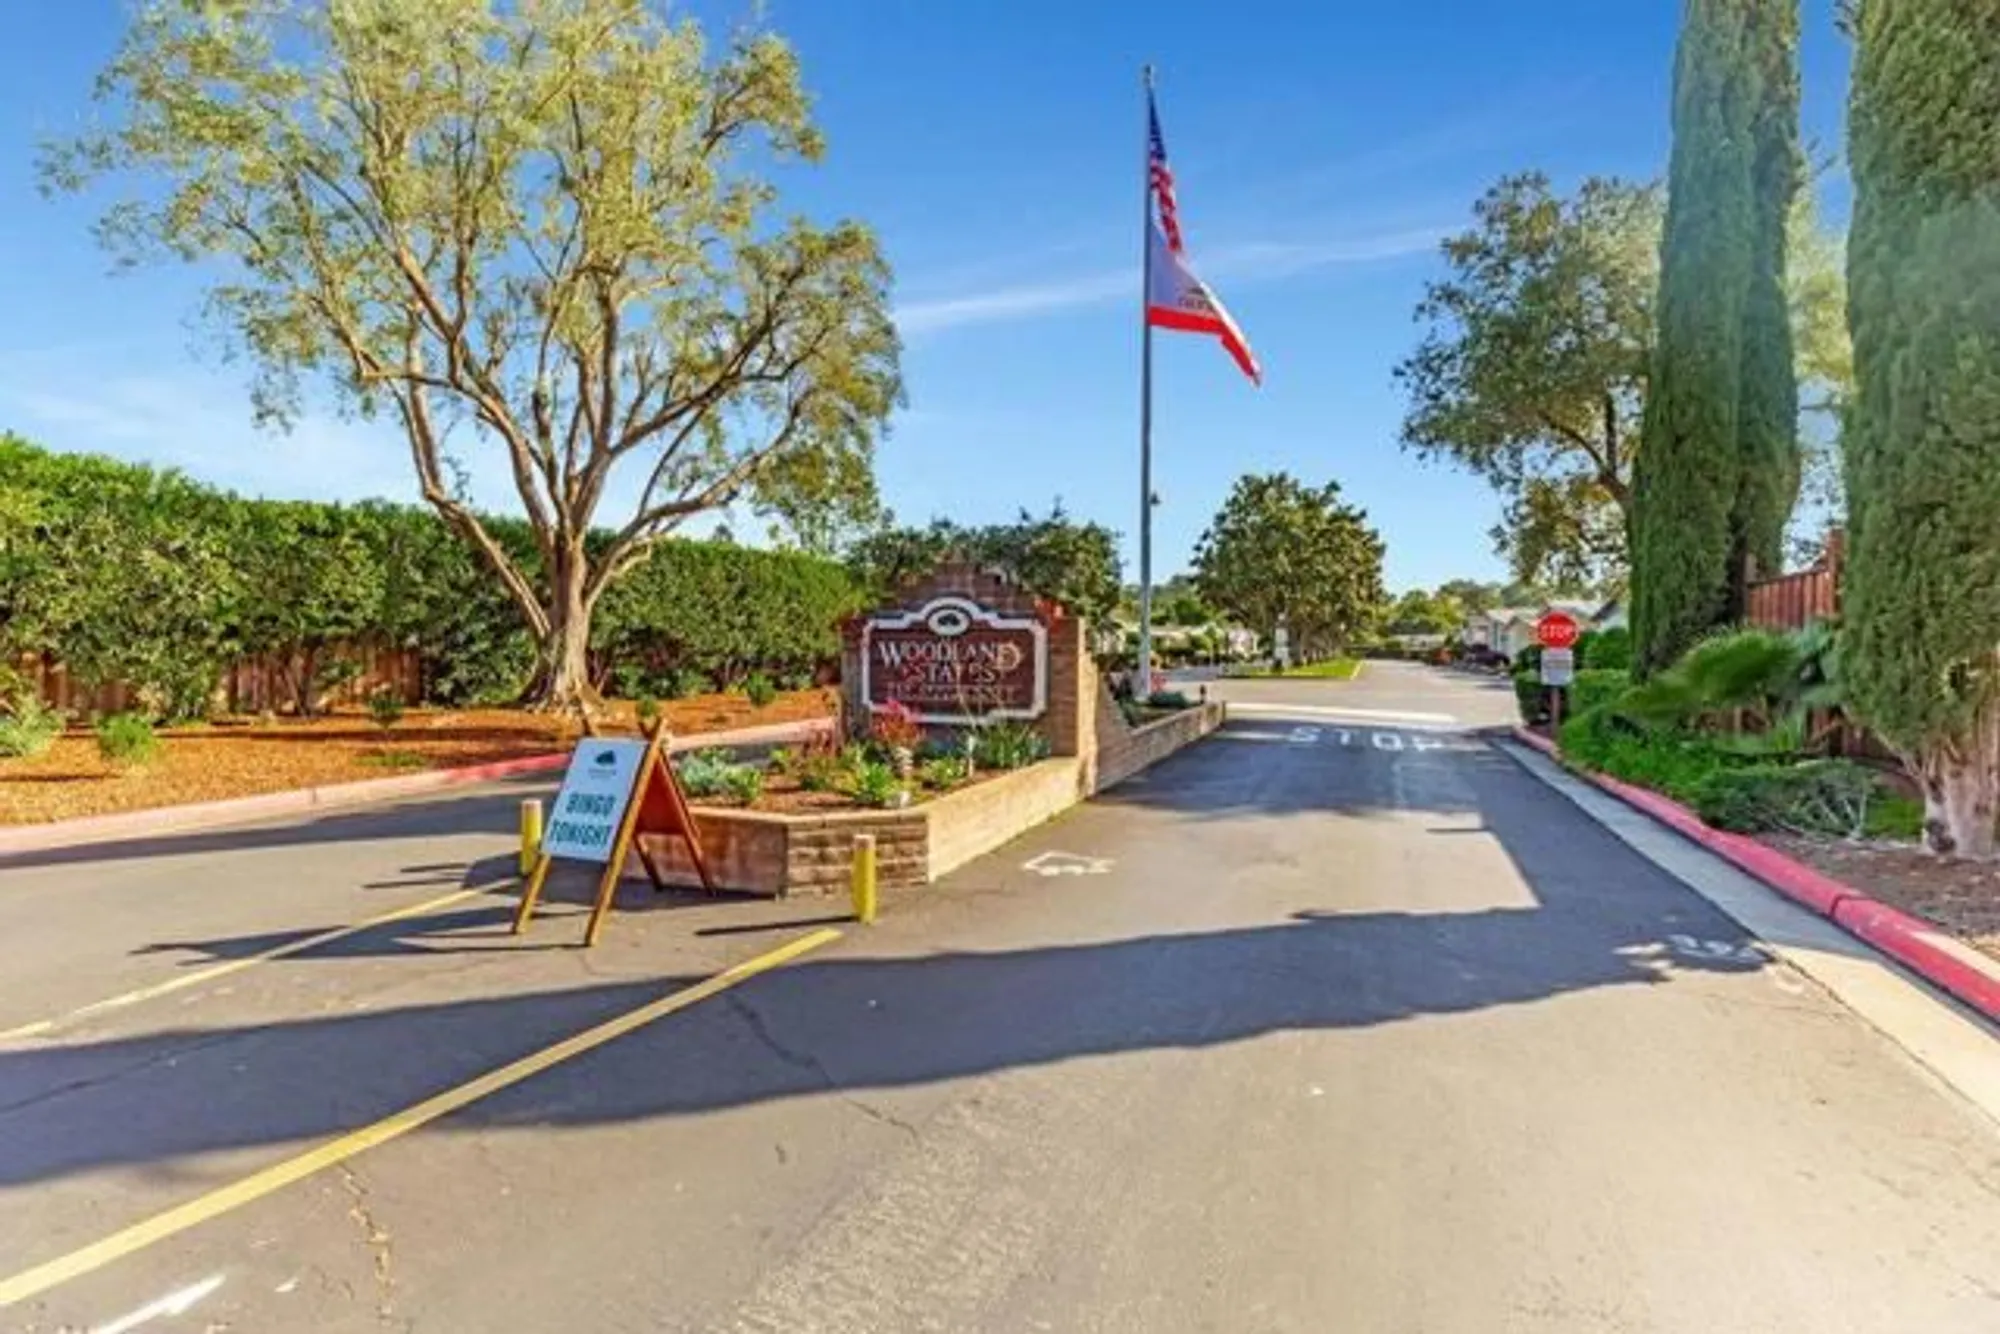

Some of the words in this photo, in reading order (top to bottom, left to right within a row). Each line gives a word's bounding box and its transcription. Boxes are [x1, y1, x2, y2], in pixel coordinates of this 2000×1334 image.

[1539, 624, 1573, 639] STOP
[878, 640, 1022, 672] WOODLAND
[1288, 726, 1443, 752] STOP
[567, 793, 617, 816] BINGO
[551, 820, 613, 846] TONIGHT
